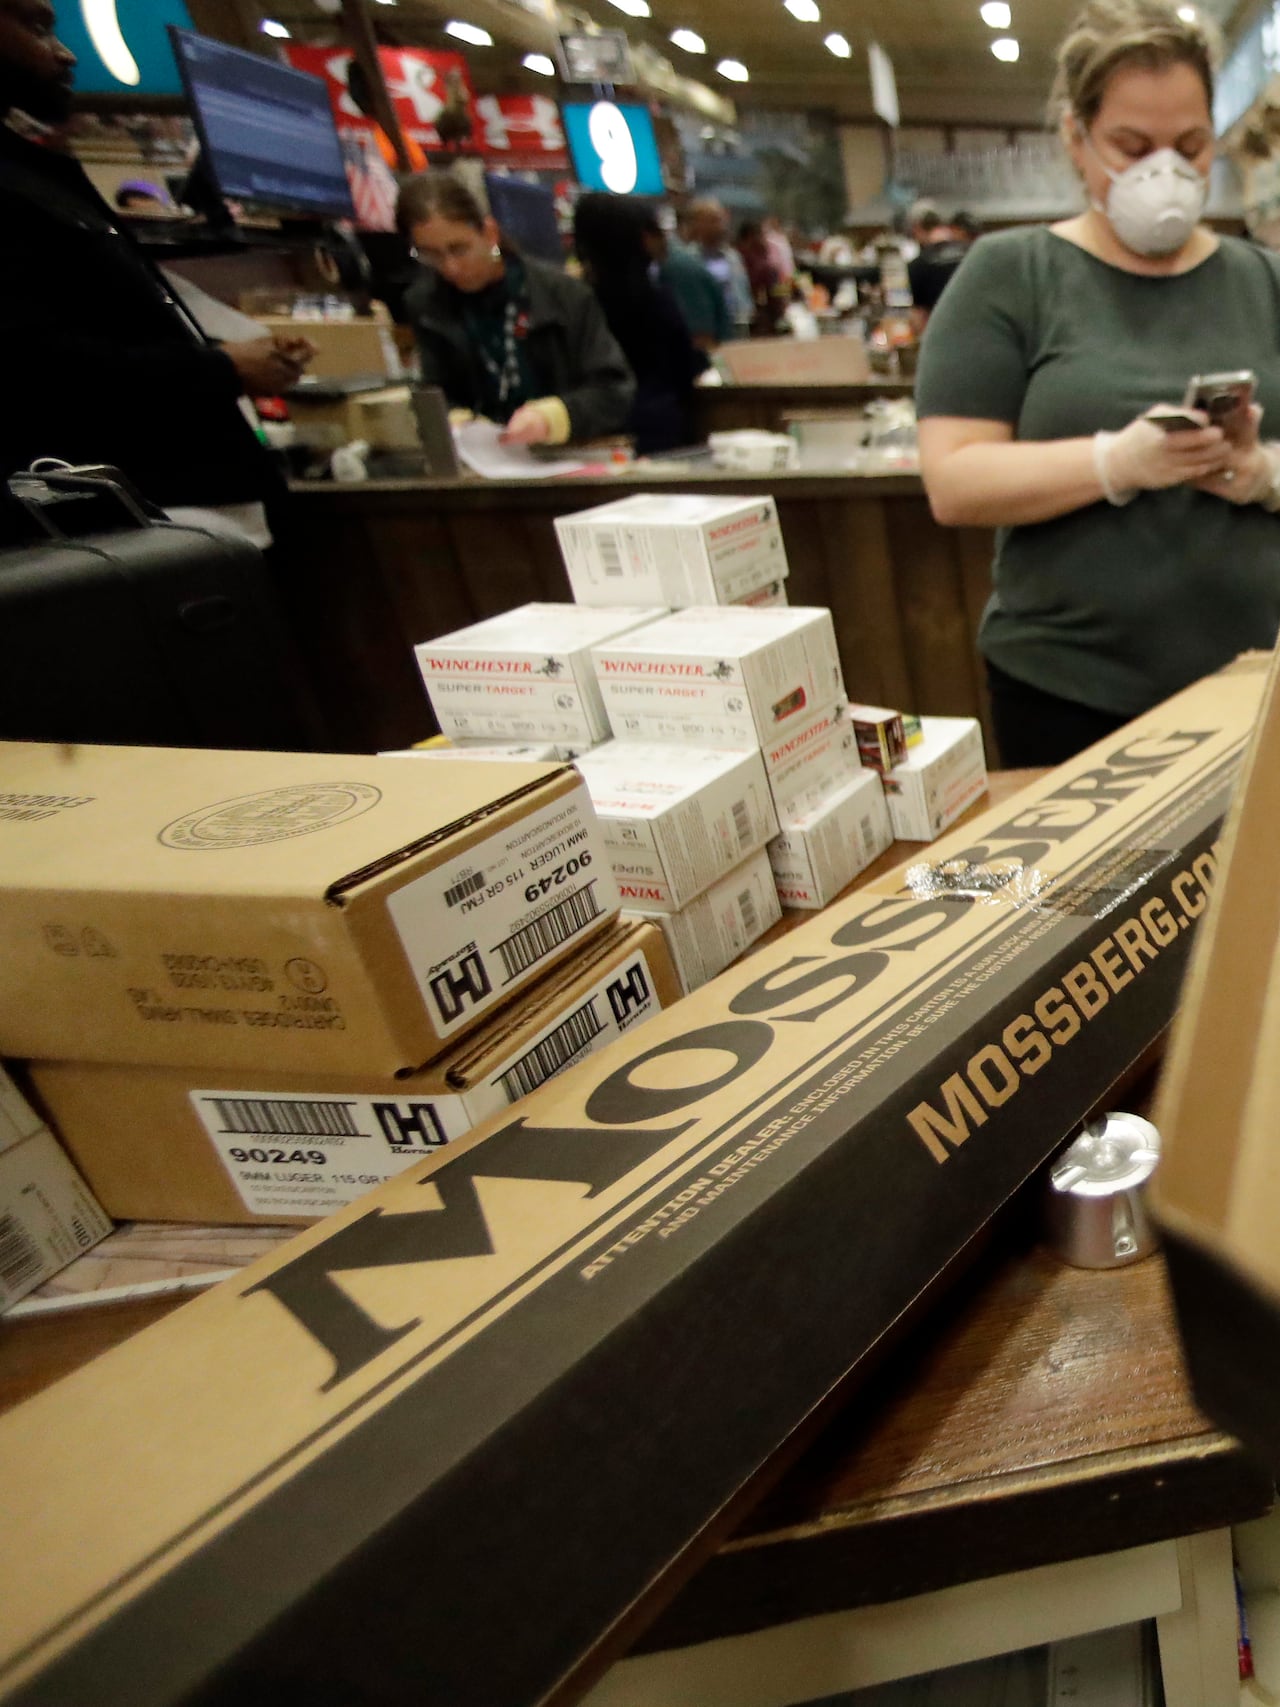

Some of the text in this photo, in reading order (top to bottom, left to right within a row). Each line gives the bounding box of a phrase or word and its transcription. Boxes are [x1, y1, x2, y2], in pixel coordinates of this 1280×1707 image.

[426, 658, 532, 673] WINCHESTER
[601, 659, 704, 676] WINCHESTER
[437, 683, 536, 696] SUPER TARGET
[610, 685, 705, 698] SUPER TARGET
[625, 719, 640, 730] 12
[770, 718, 830, 763] WINCHESTER
[621, 828, 638, 841] 12
[460, 827, 589, 915] 9MM LUGER 115 GR FMJ
[525, 849, 593, 903] 90249
[426, 940, 478, 979] Hornady
[972, 953, 997, 972] GUN
[949, 975, 968, 990] IS
[968, 969, 979, 979] A
[906, 841, 1222, 1164] MOSSBERG.CO
[906, 986, 954, 1023] CARTON
[618, 1001, 651, 1032] Hornady
[875, 1023, 911, 1047] THIS
[240, 729, 1223, 1393] MOSSBERG
[858, 1044, 881, 1060] IN
[658, 939, 1035, 1240] AND MAINTENANCE INFORMATION. BE SURE THE CUSTOMER
[791, 1058, 863, 1114] ENCLOSED
[229, 1147, 327, 1166] 90249
[708, 1114, 793, 1177] DEALER:
[239, 1170, 271, 1182] 9MM
[275, 1172, 324, 1184] LUGER
[330, 1173, 356, 1185] 115
[358, 1174, 380, 1186] GR
[71, 1215, 92, 1247] Olin
[579, 1177, 711, 1281] ATTENTION
